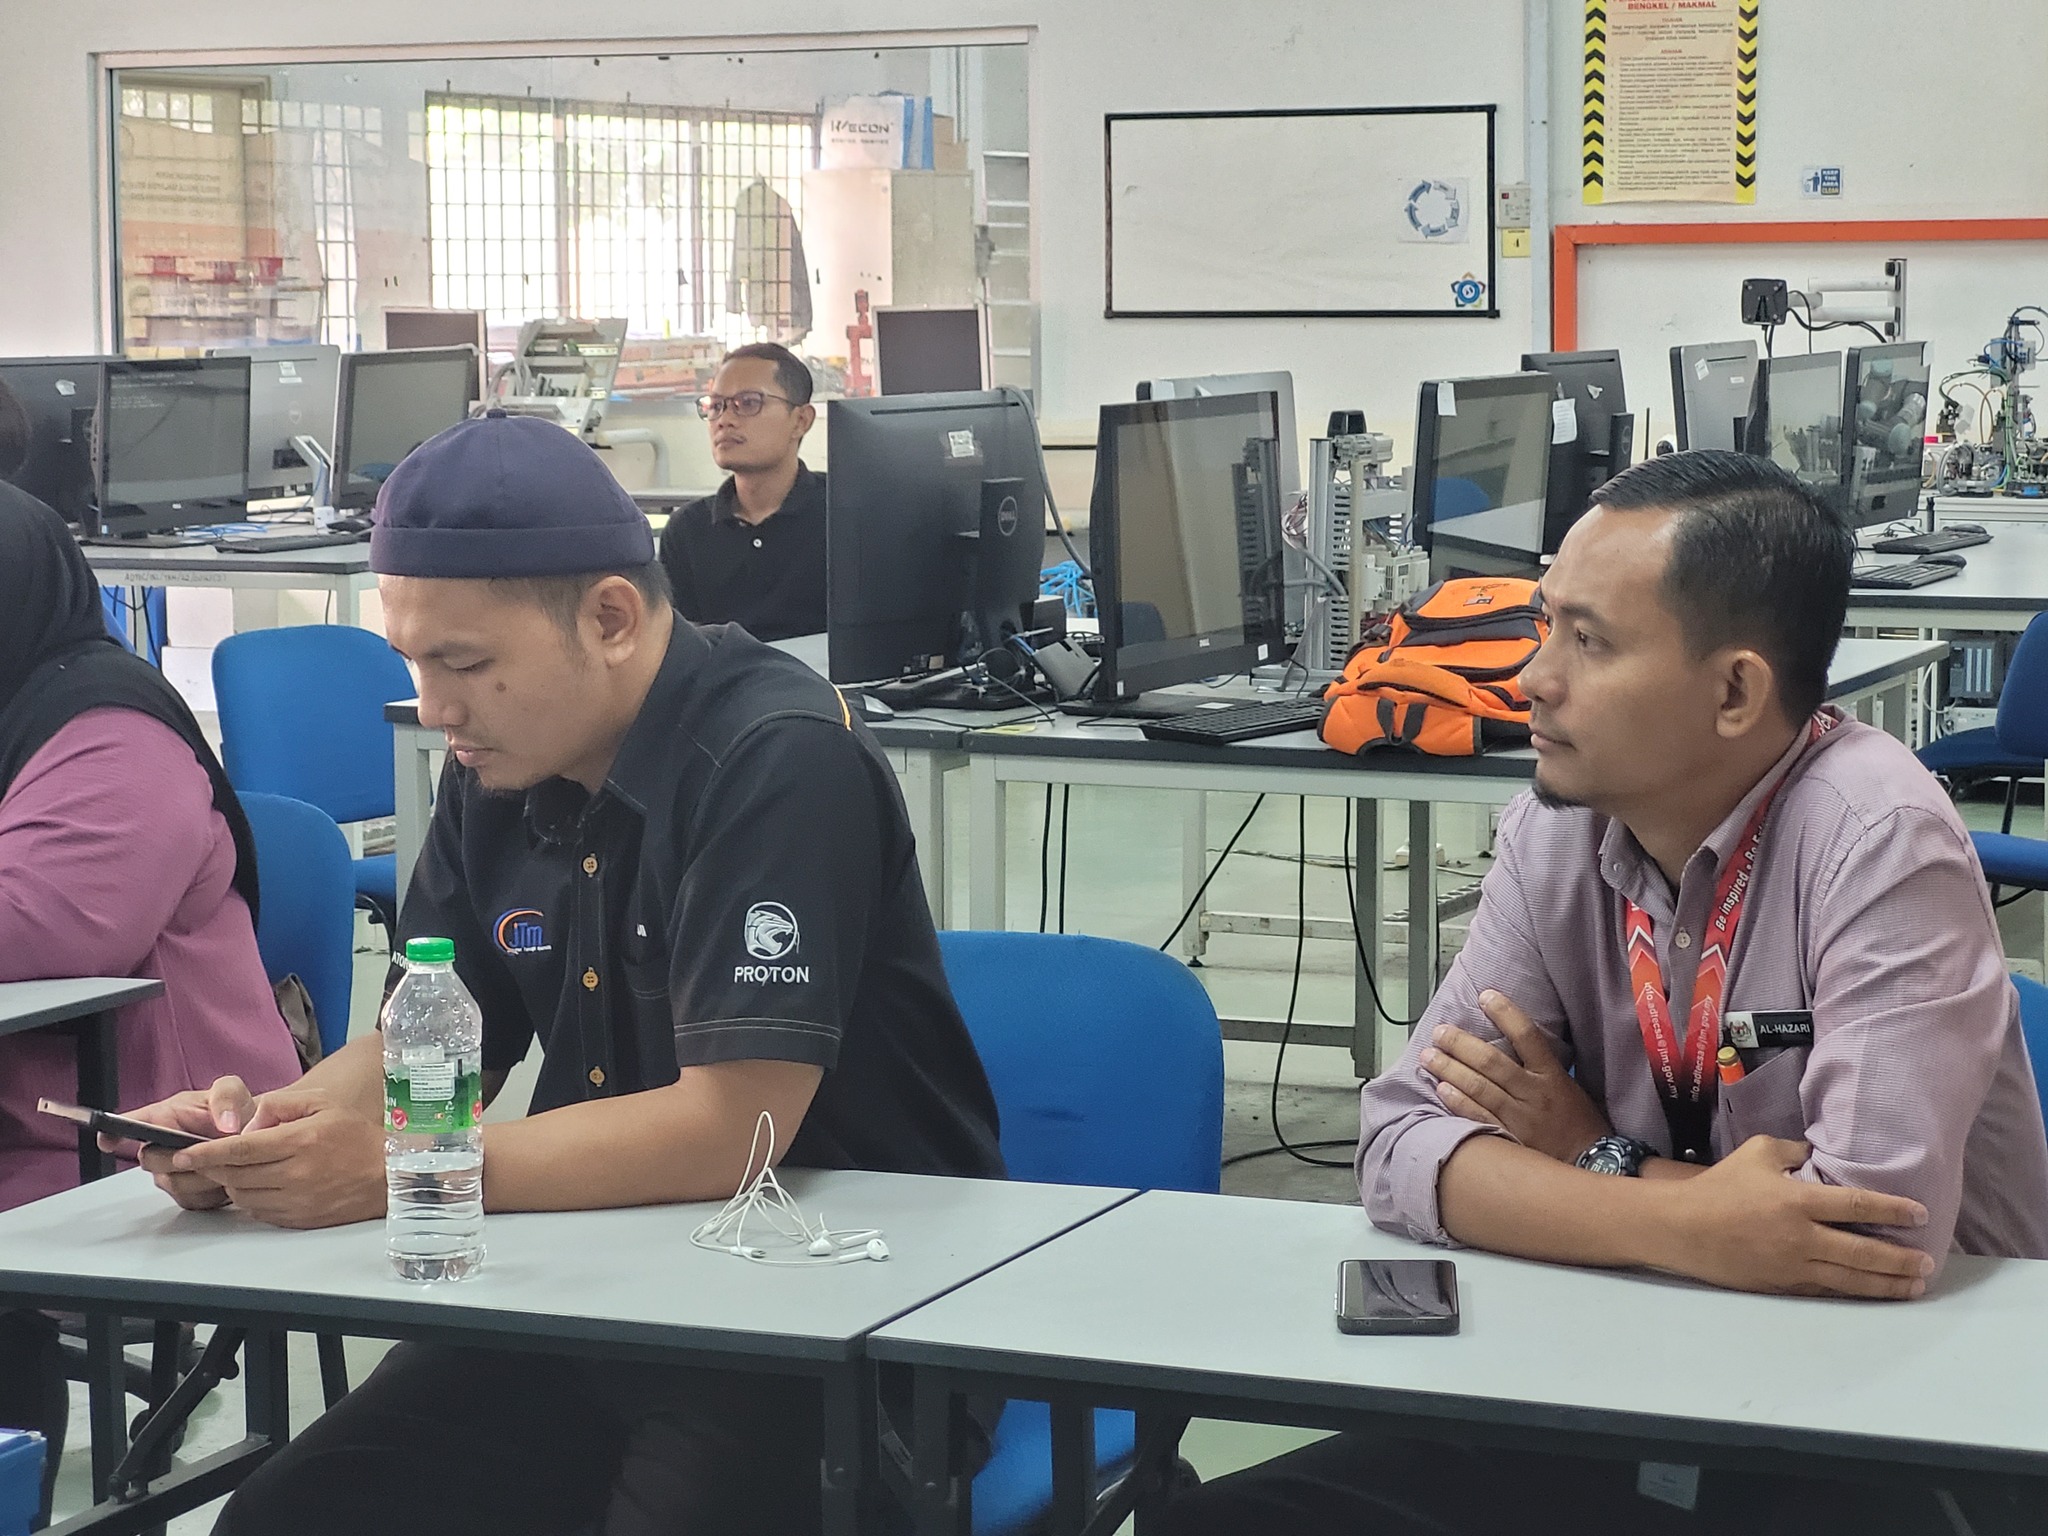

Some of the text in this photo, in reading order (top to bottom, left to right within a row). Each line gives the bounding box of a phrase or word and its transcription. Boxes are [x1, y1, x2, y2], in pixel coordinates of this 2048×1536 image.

[1628, 2, 1669, 10] BENGKEL
[1718, 869, 1749, 914] inspired
[1714, 914, 1727, 932] Be
[734, 965, 810, 984] PROTON
[1760, 1023, 1810, 1034] AL-HAZARI
